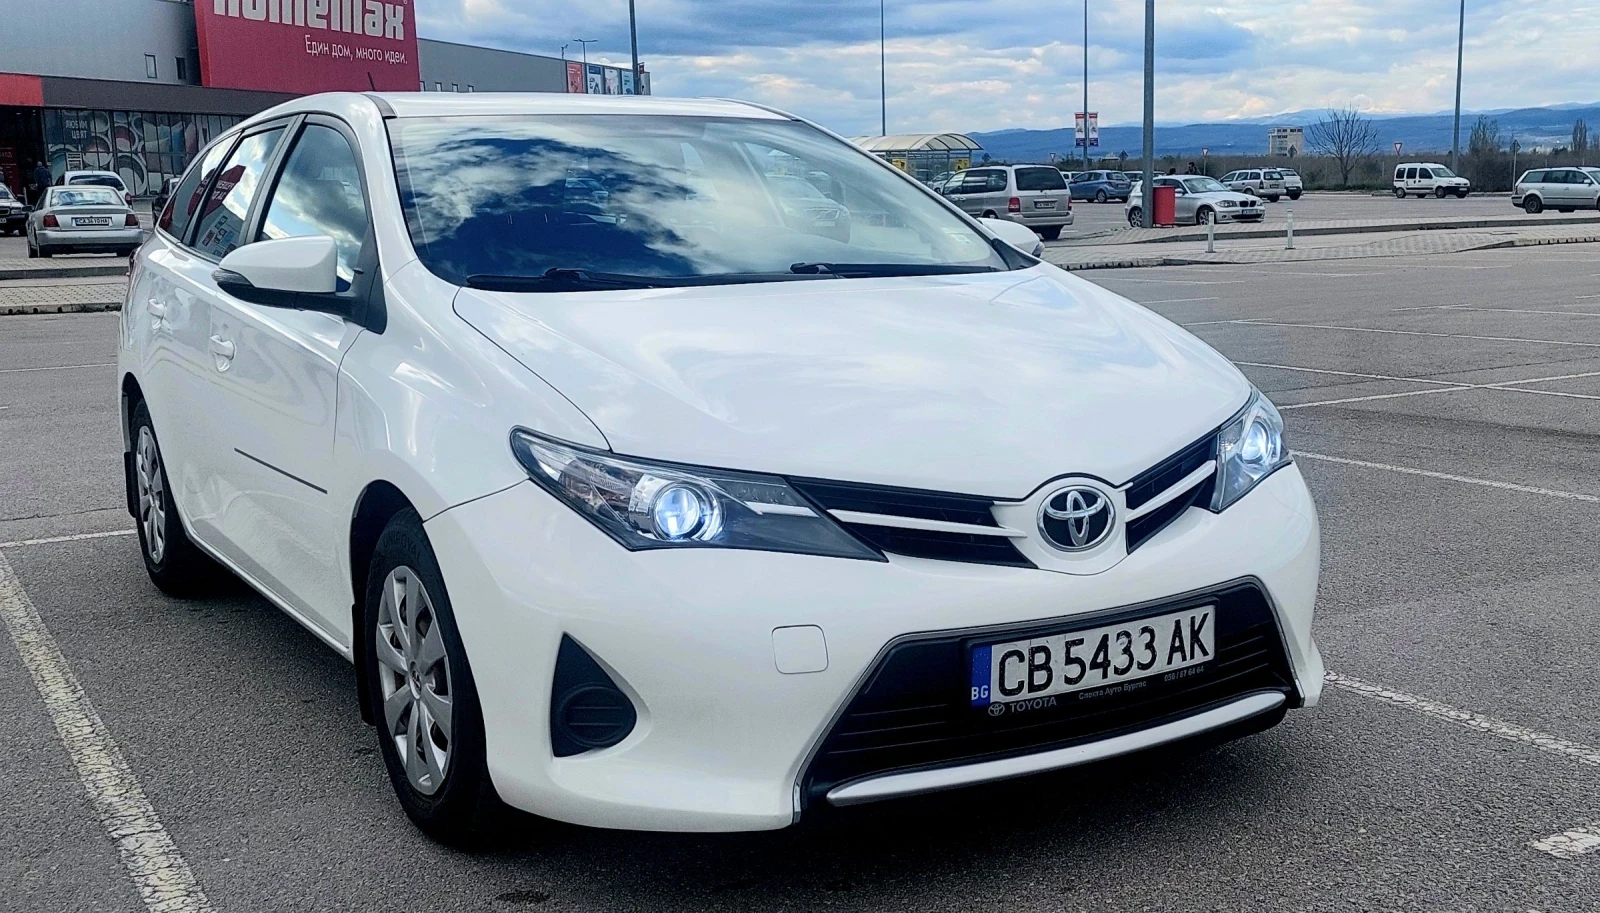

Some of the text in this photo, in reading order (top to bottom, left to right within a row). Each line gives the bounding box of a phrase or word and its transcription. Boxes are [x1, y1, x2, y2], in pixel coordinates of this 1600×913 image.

[304, 34, 408, 65] Един дом, много идеи.
[998, 612, 1210, 697] CB 5433 AK
[971, 685, 988, 700] BG
[1105, 686, 1122, 696] Ауто
[1124, 680, 1147, 693] Бургас
[1010, 696, 1057, 713] TOYOTA
